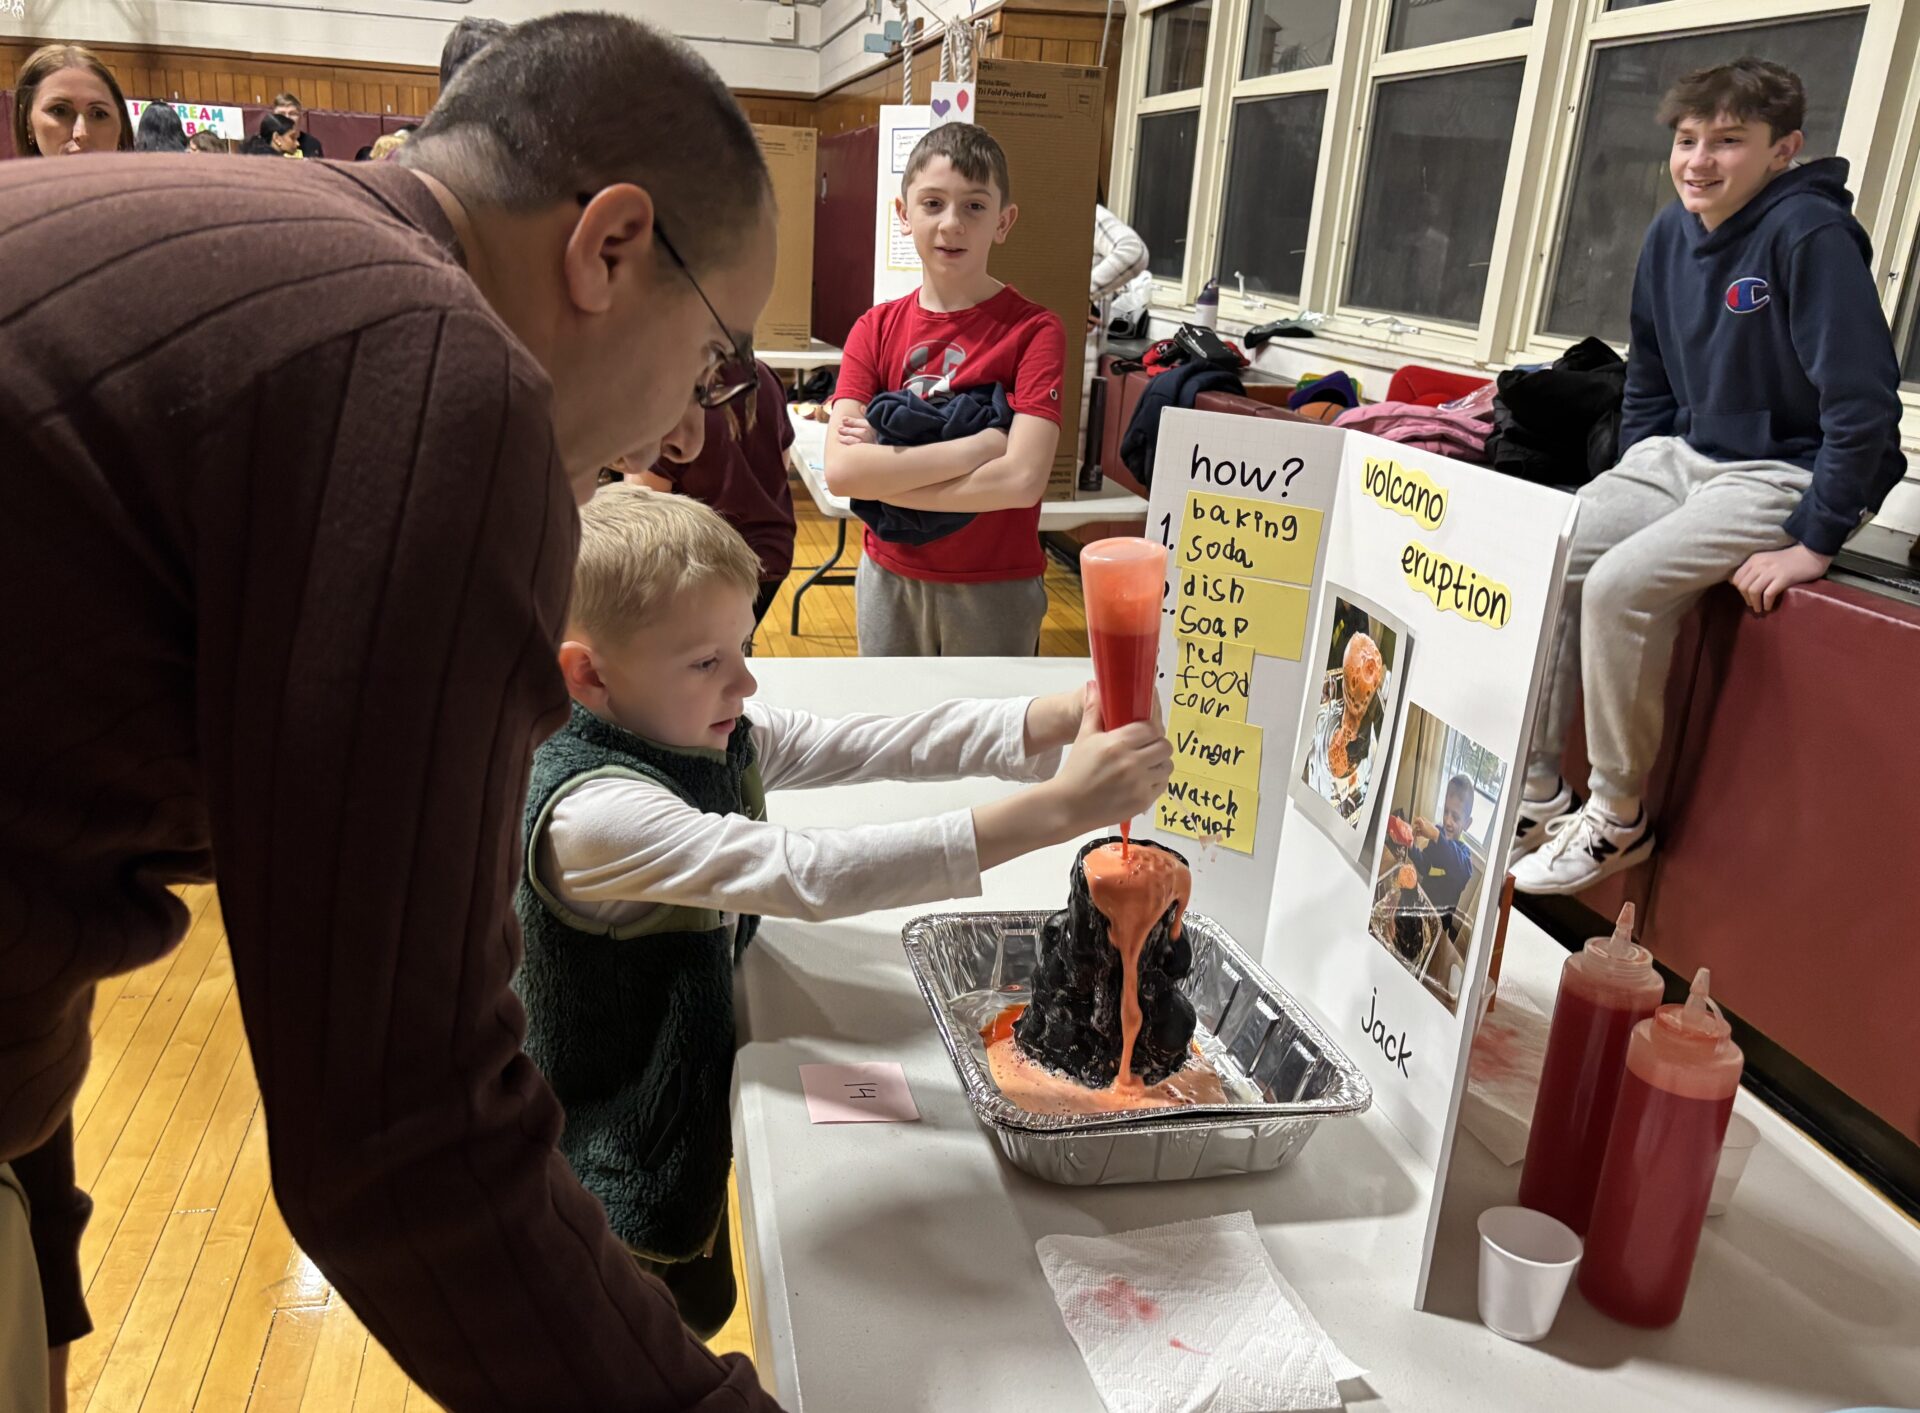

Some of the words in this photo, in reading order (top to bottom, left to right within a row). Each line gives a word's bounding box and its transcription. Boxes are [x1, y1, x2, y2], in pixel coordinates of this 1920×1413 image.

[987, 88, 1001, 96] Fold
[1002, 90, 1025, 98] Project
[170, 105, 224, 122] REAM
[1191, 443, 1304, 498] how?
[1365, 461, 1444, 522] volcano
[1193, 498, 1298, 541] baking
[1183, 574, 1245, 604] dish
[1401, 545, 1507, 625] eruption
[1186, 641, 1223, 666] red
[1176, 665, 1250, 697] food
[1173, 693, 1230, 718] color
